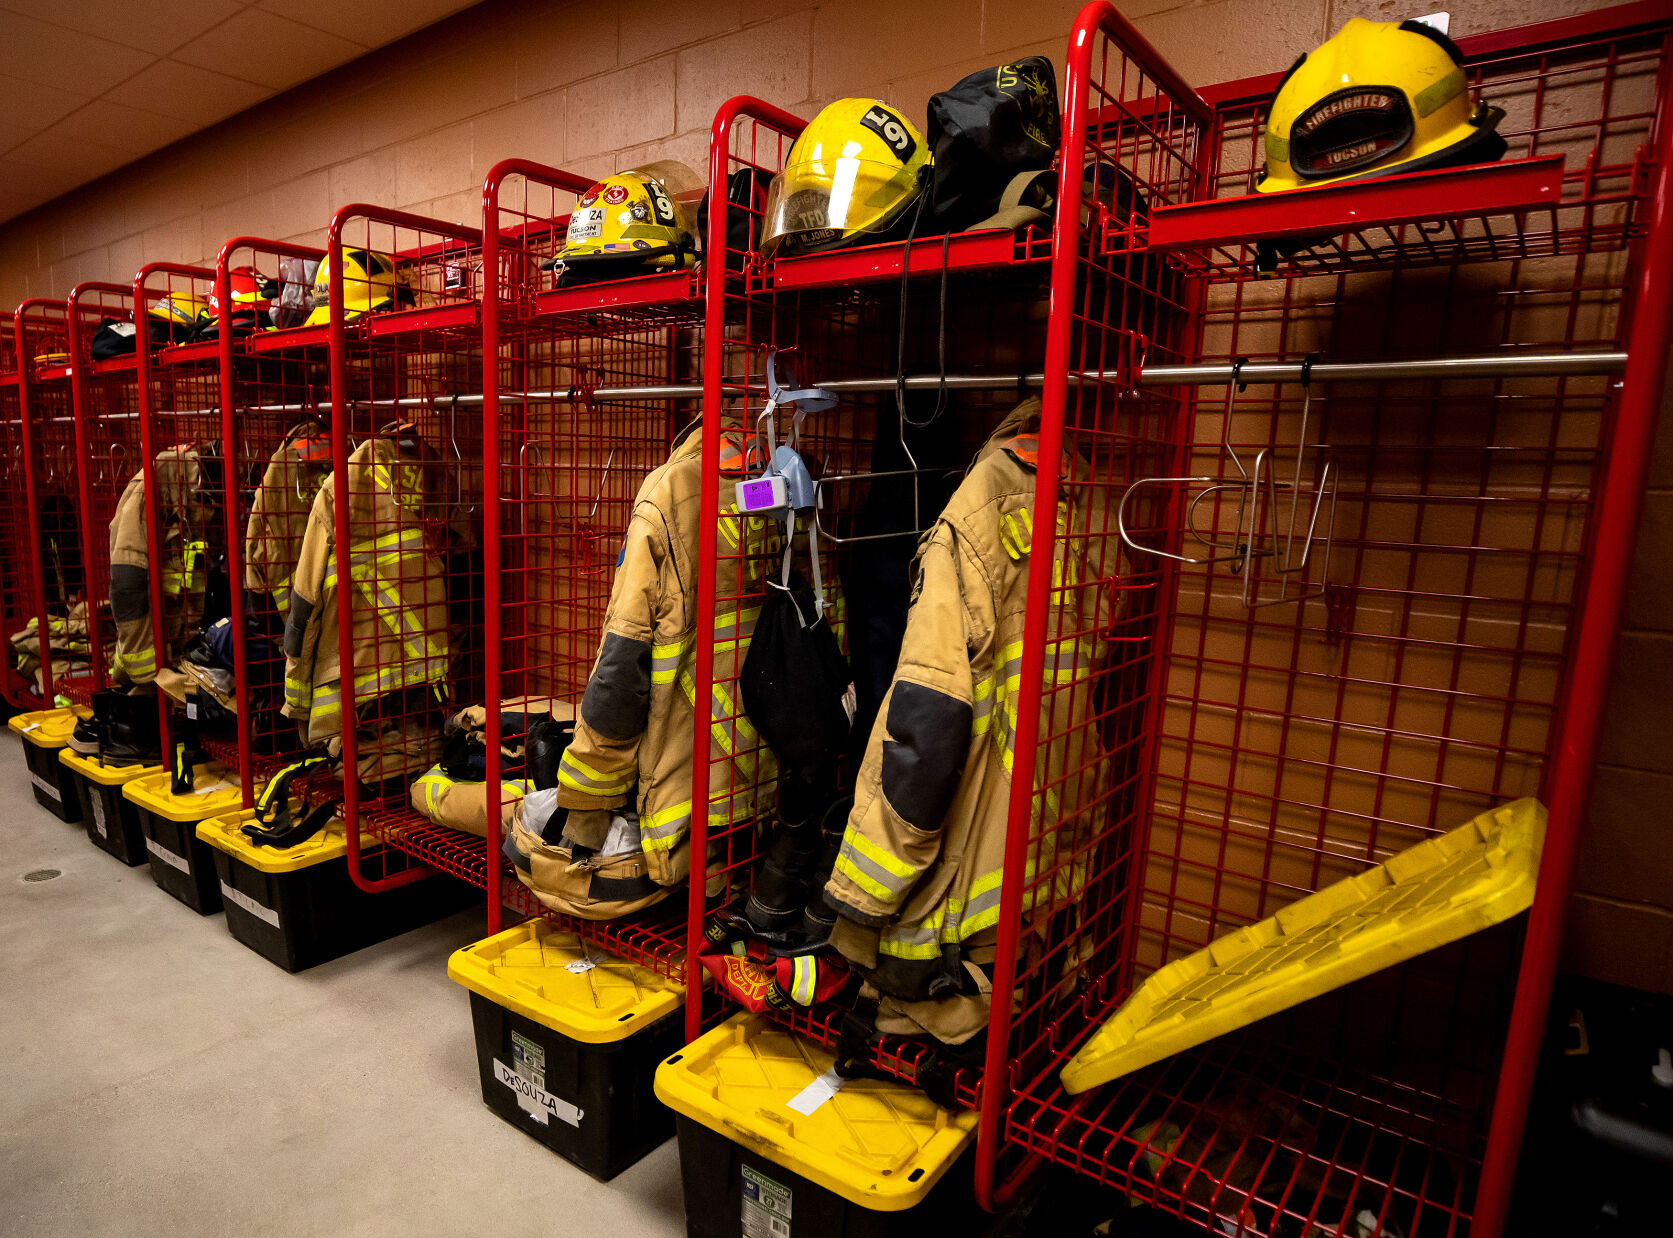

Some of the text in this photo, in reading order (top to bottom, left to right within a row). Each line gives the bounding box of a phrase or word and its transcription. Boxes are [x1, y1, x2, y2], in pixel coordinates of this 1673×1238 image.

[1306, 95, 1388, 131] FIREFIGHTER
[865, 110, 908, 150] 19
[1328, 140, 1375, 164] TUCSON
[571, 225, 597, 235] TUCSON
[799, 209, 824, 229] TFD
[811, 229, 835, 241] JONES
[744, 1168, 790, 1196] Greenmade
